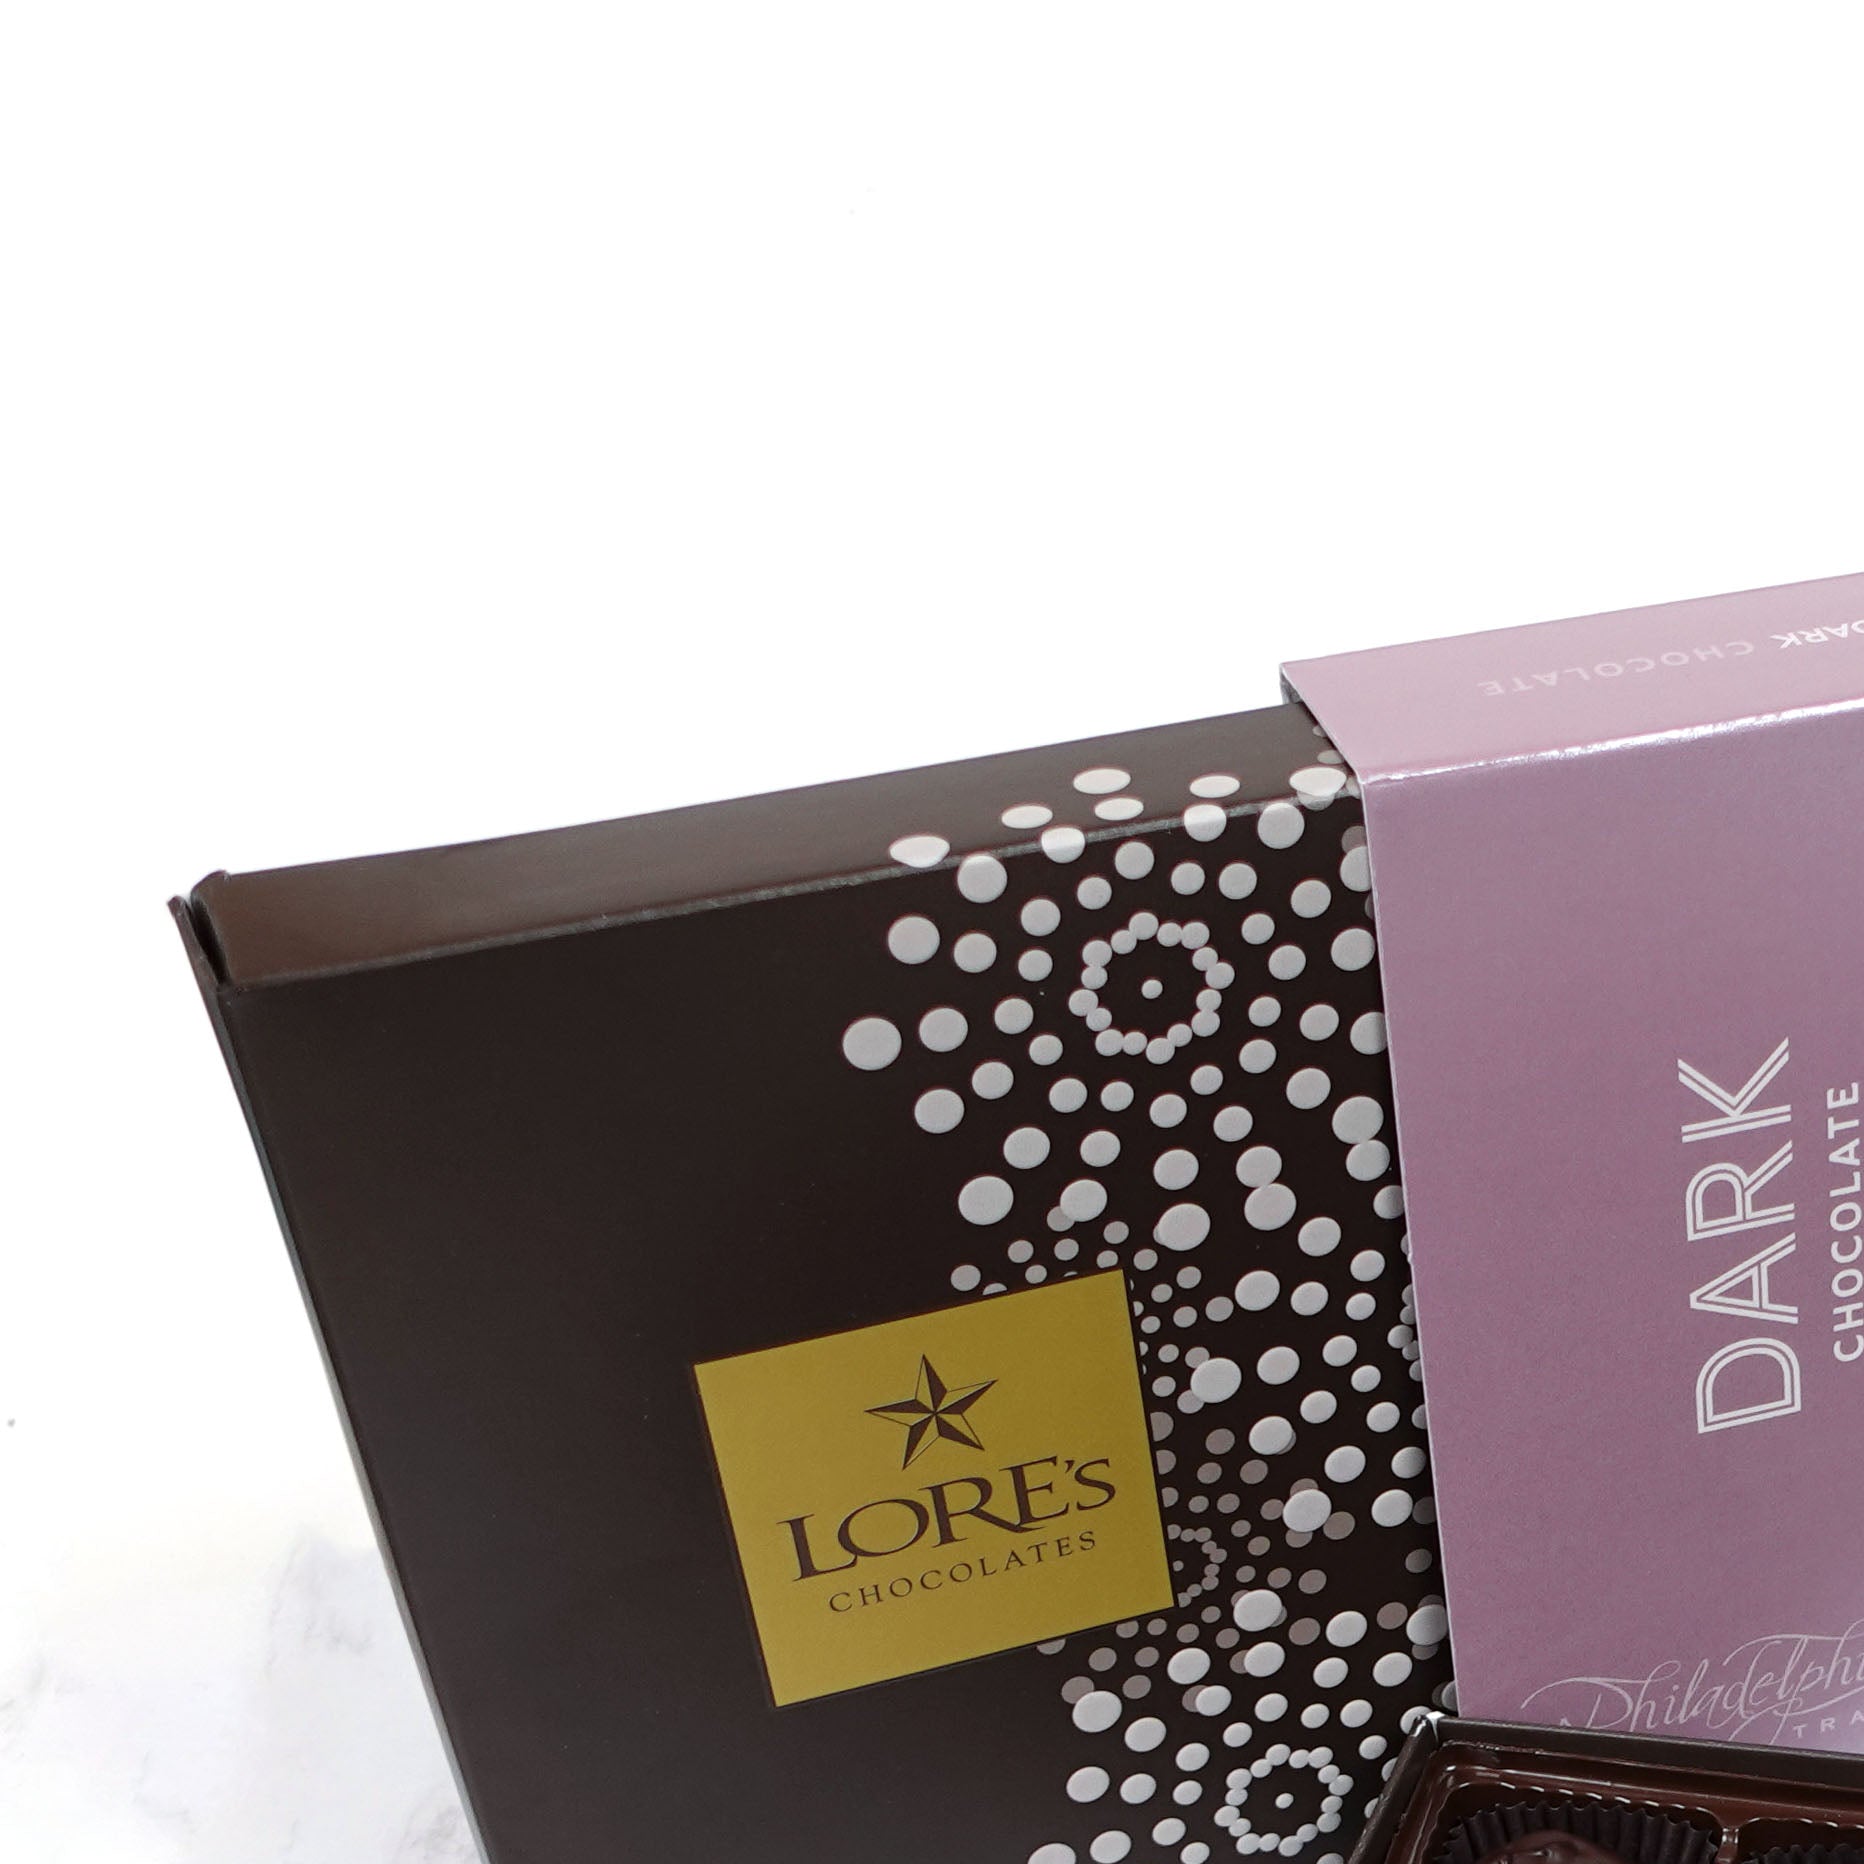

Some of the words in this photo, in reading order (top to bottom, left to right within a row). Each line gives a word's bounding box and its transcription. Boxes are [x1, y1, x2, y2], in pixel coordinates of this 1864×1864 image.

[1479, 641, 1755, 697] CHOCOLATE
[1677, 1036, 1801, 1434] DARK
[776, 1456, 1117, 1582] LORE'S
[829, 1531, 1097, 1612] CHOCOLATES
